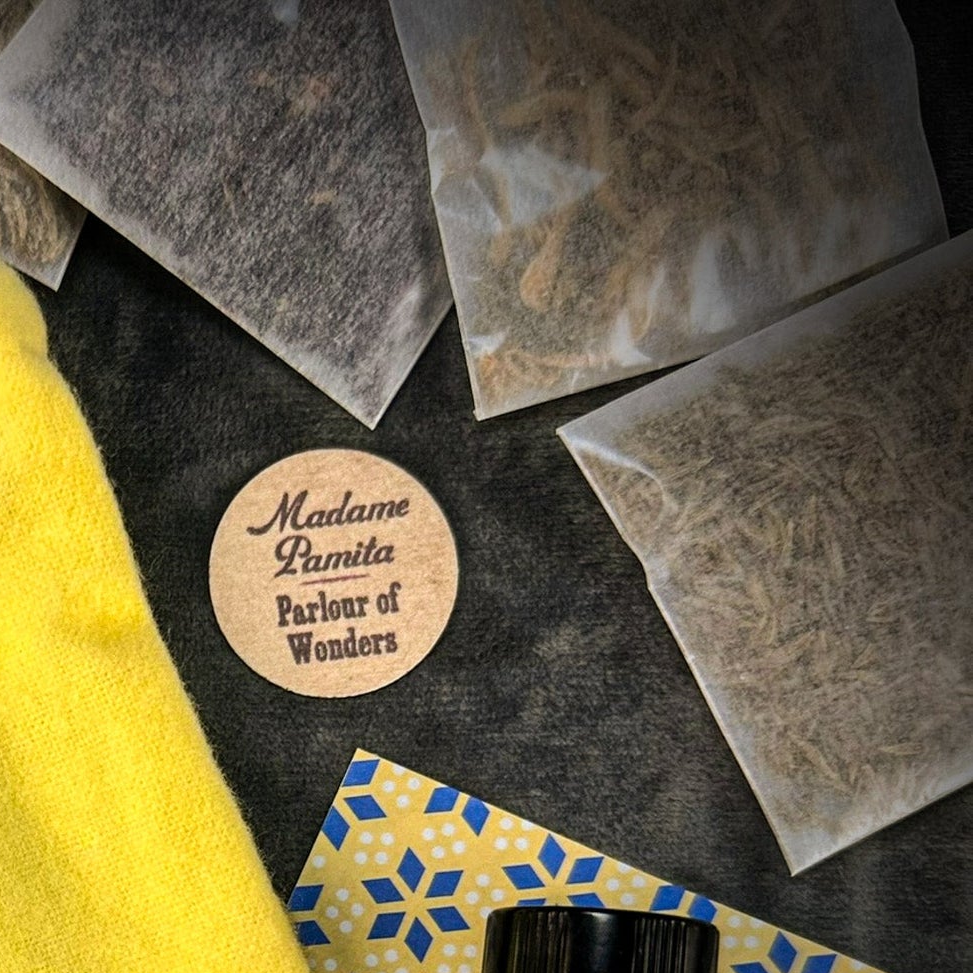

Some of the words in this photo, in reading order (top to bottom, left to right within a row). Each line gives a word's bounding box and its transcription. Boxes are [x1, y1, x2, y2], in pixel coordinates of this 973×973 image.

[246, 490, 410, 536] Madame
[274, 535, 395, 578] Pamita
[276, 591, 370, 628] Parlour
[376, 582, 402, 614] of
[287, 627, 399, 665] Wonders
